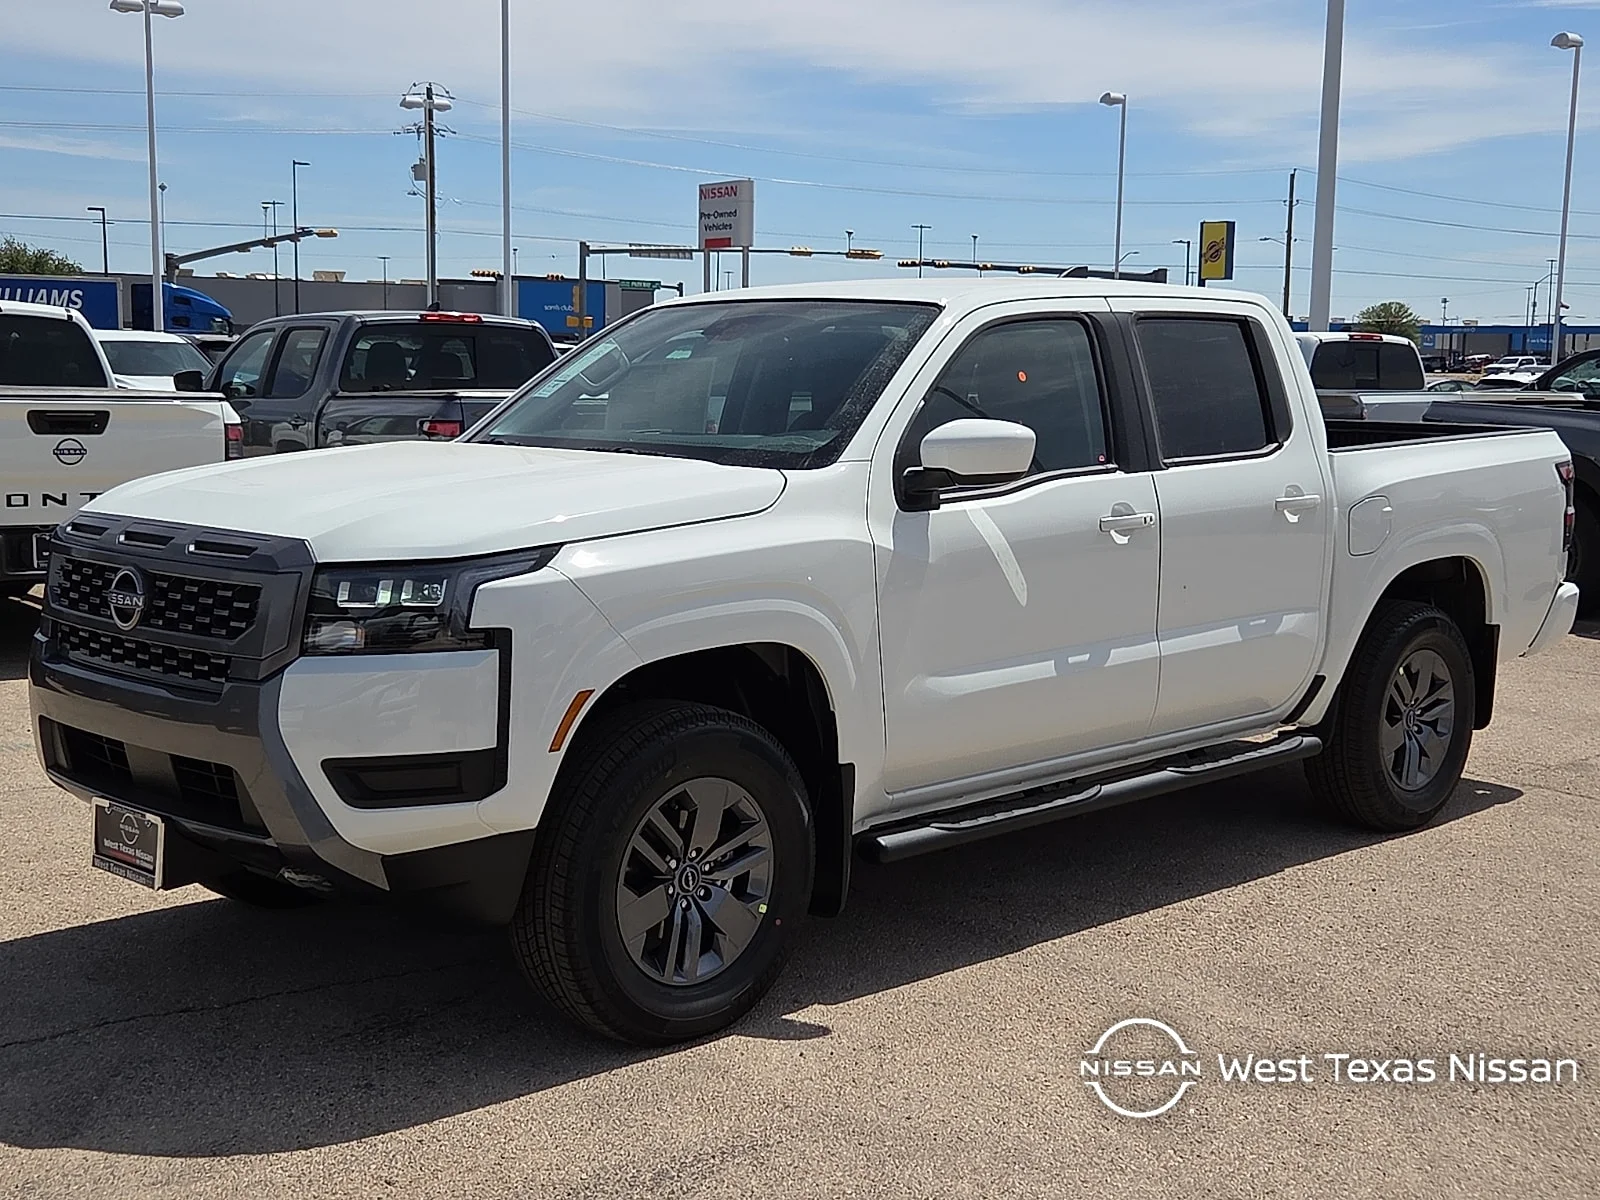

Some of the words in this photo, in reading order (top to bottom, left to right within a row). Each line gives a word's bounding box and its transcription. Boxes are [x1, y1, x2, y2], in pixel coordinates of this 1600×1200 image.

[701, 186, 737, 200] NISSAN
[701, 209, 737, 220] Pre-Owned
[704, 222, 732, 232] Vehicles
[103, 838, 119, 850] West
[119, 843, 135, 856] Texas
[136, 849, 154, 862] Nissan
